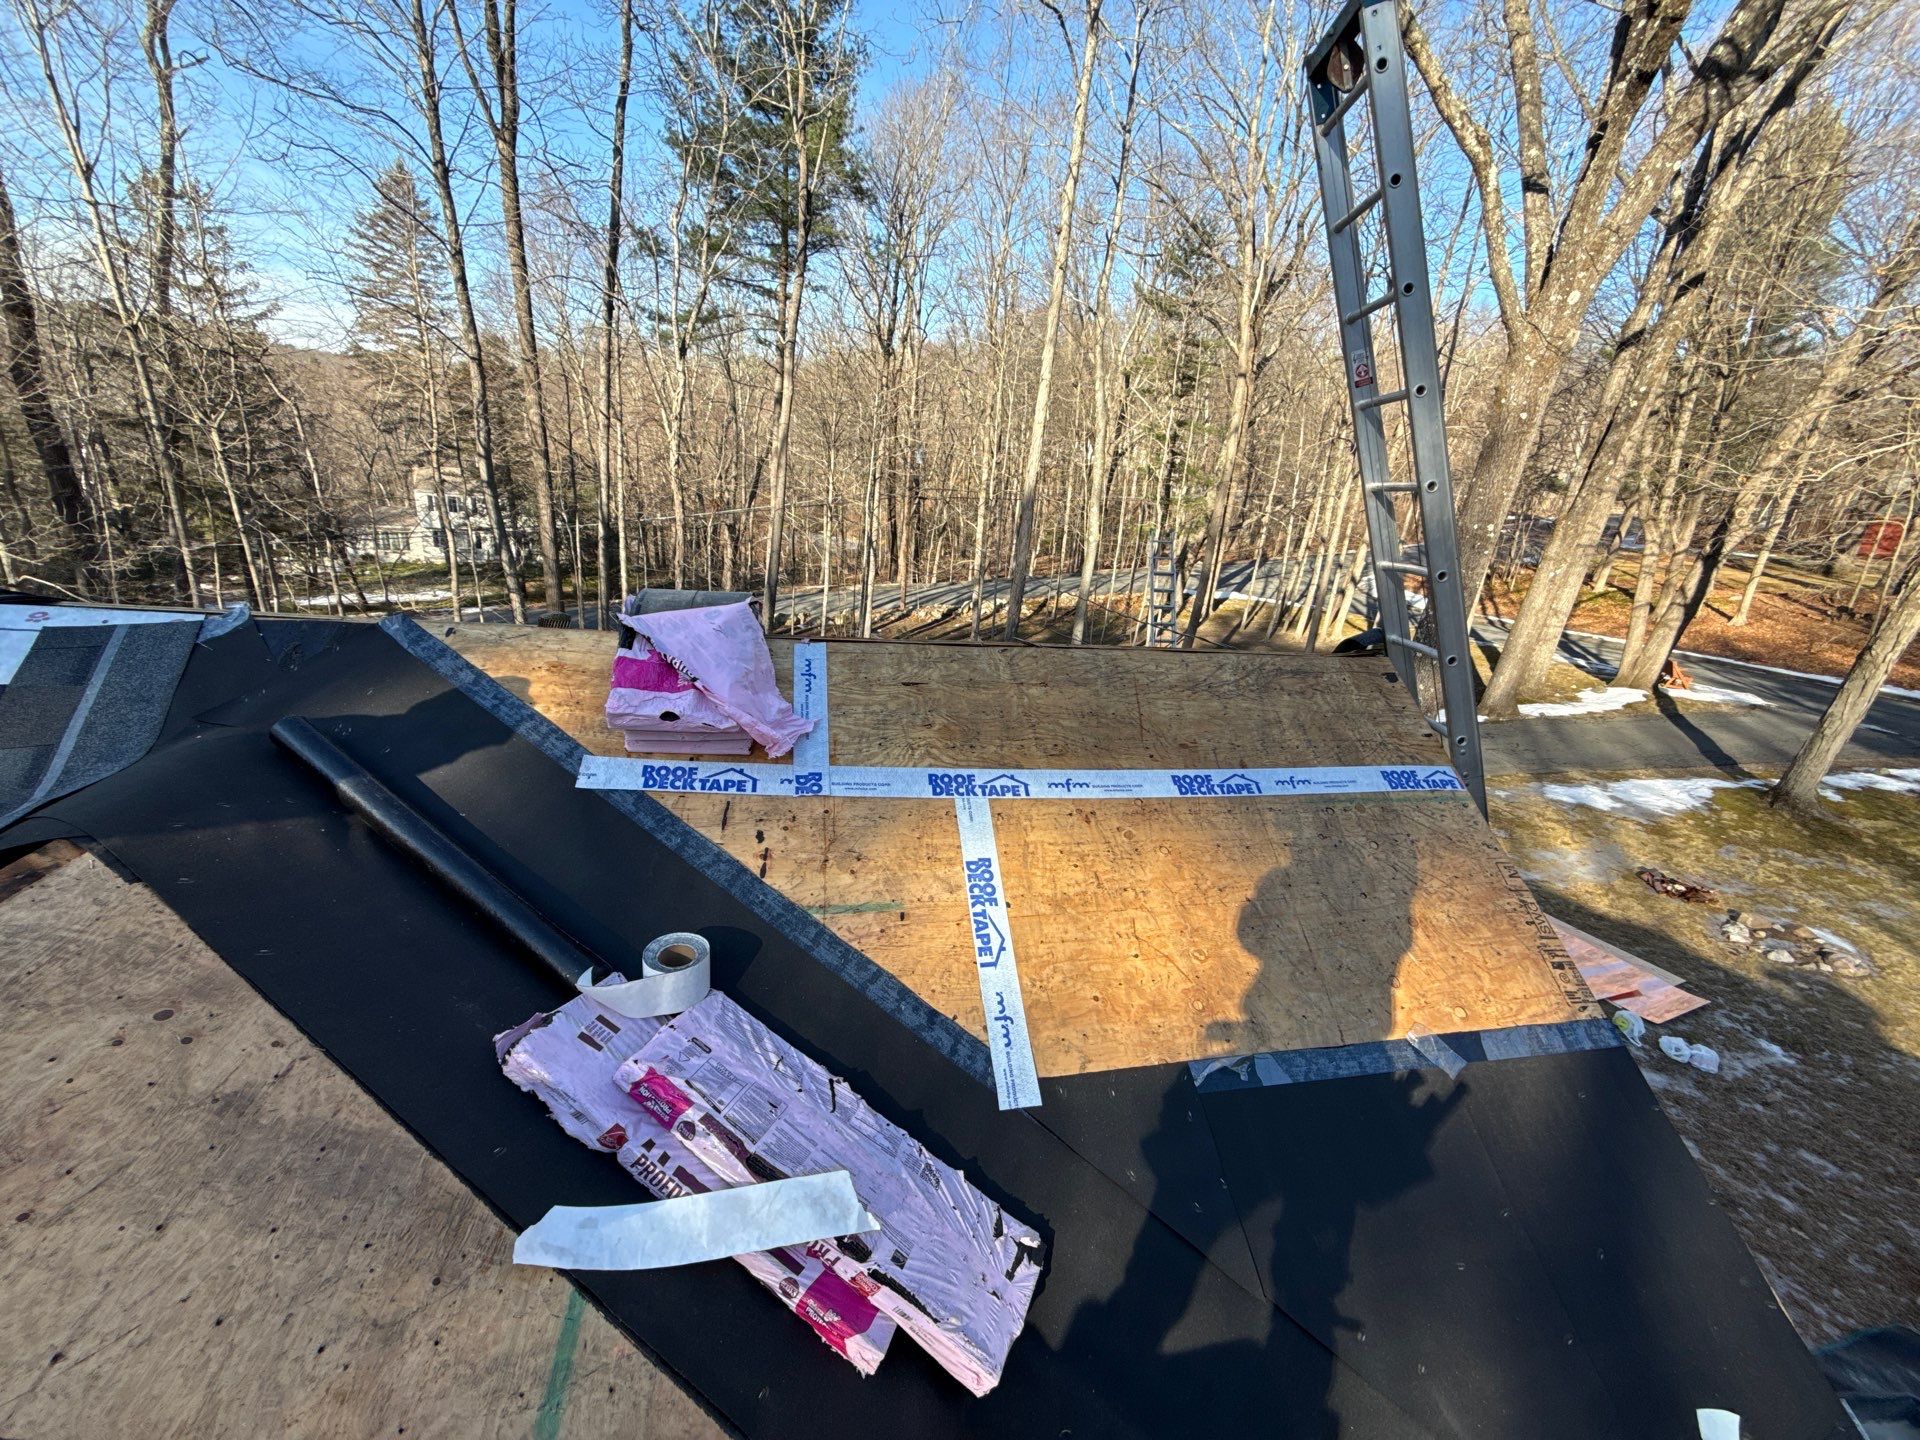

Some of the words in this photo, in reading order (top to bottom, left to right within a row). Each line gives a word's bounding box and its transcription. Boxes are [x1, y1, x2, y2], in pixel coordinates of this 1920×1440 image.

[800, 658, 817, 693] mfm
[641, 764, 699, 779] ROOF
[1379, 770, 1420, 781] ROOF
[927, 773, 976, 786] ROOF
[1048, 778, 1089, 793] mfm
[1170, 774, 1213, 786] ROOF
[1275, 776, 1311, 789] mfm
[977, 857, 999, 907] ROOF
[994, 991, 1014, 1048] mfm
